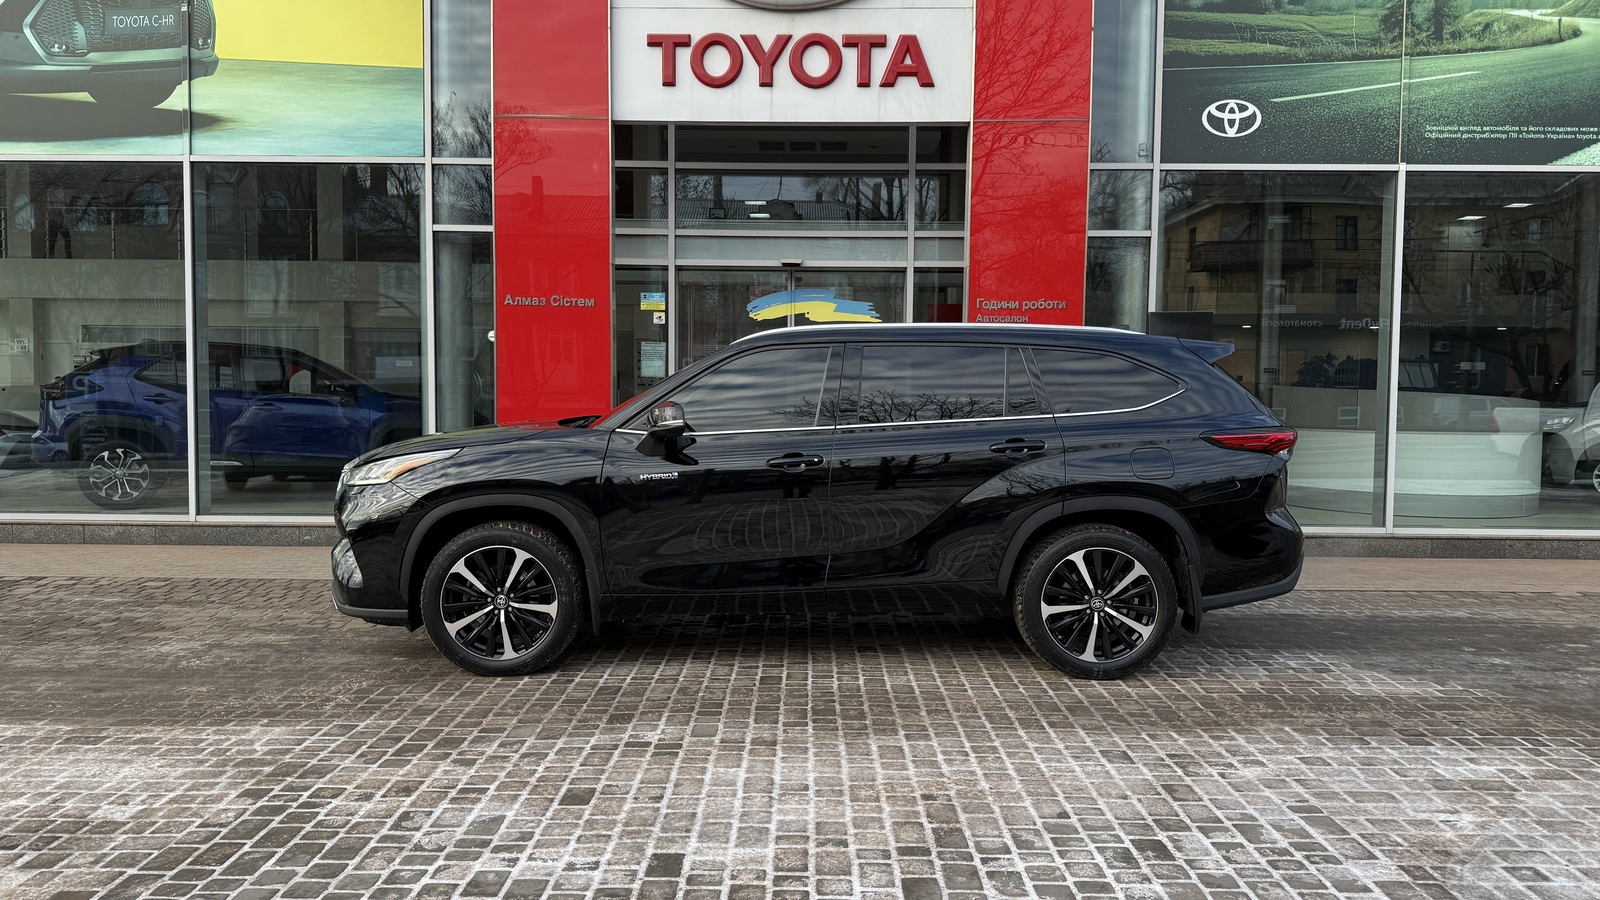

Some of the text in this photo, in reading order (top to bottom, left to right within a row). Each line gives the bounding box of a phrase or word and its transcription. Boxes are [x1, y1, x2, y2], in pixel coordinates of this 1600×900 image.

[112, 14, 175, 28] TOYOTA C-HR
[647, 32, 935, 89] TOYOTA
[1528, 124, 1544, 132] його
[1424, 131, 1461, 139] Офіційний
[504, 294, 595, 307] Алмаз Сістем
[976, 298, 1066, 311] Години роботи
[976, 313, 1029, 323] Автосалон
